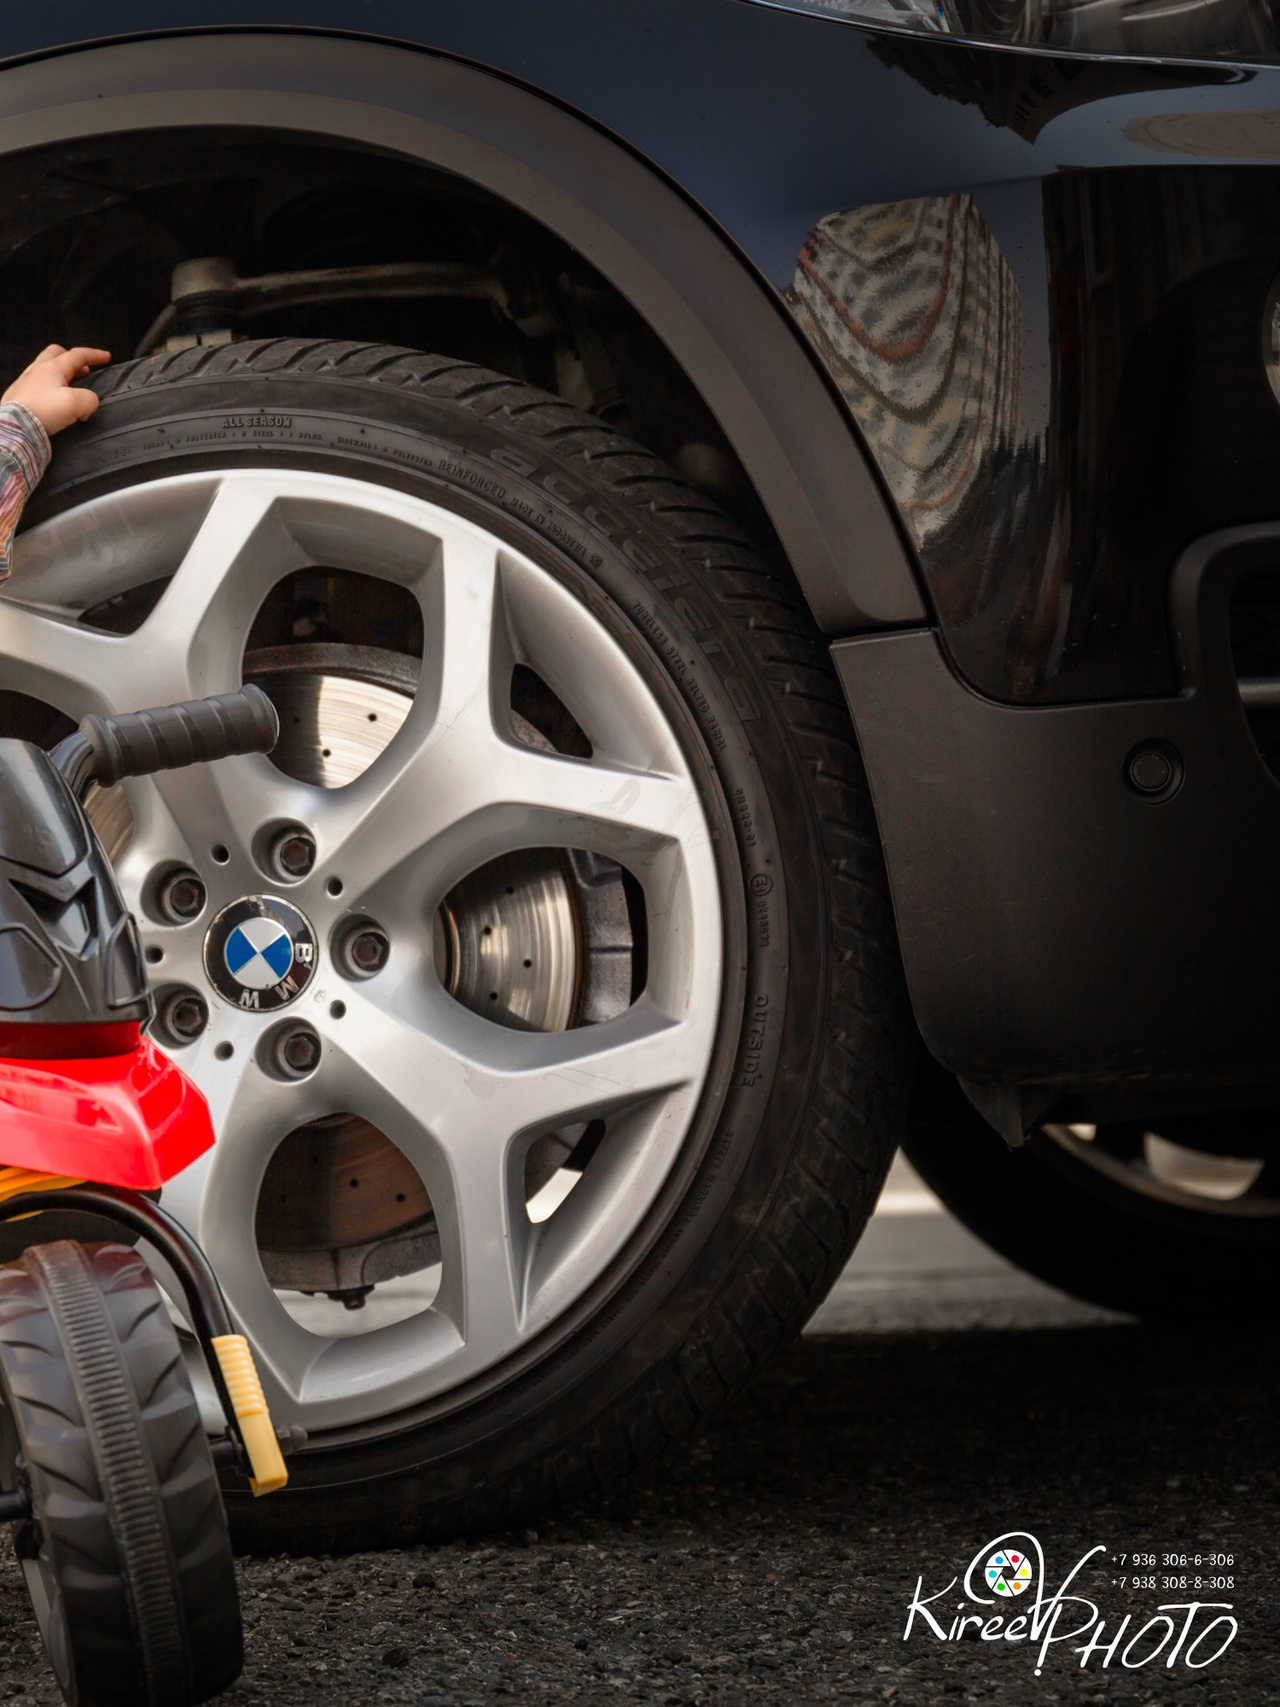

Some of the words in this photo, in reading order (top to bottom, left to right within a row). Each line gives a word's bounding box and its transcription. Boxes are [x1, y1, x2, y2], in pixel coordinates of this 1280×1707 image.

[221, 417, 243, 428] ALL
[246, 415, 292, 427] SEASON
[438, 460, 506, 499] REINFORCED
[509, 495, 535, 517] MADE
[534, 512, 546, 525] IN
[547, 521, 587, 557] INDONESIA
[632, 601, 668, 645] TUBELESS
[665, 645, 689, 677] STEEL
[683, 675, 711, 715] BELTED
[704, 714, 729, 753] RADIAL
[740, 992, 769, 1088] OUTSIDE
